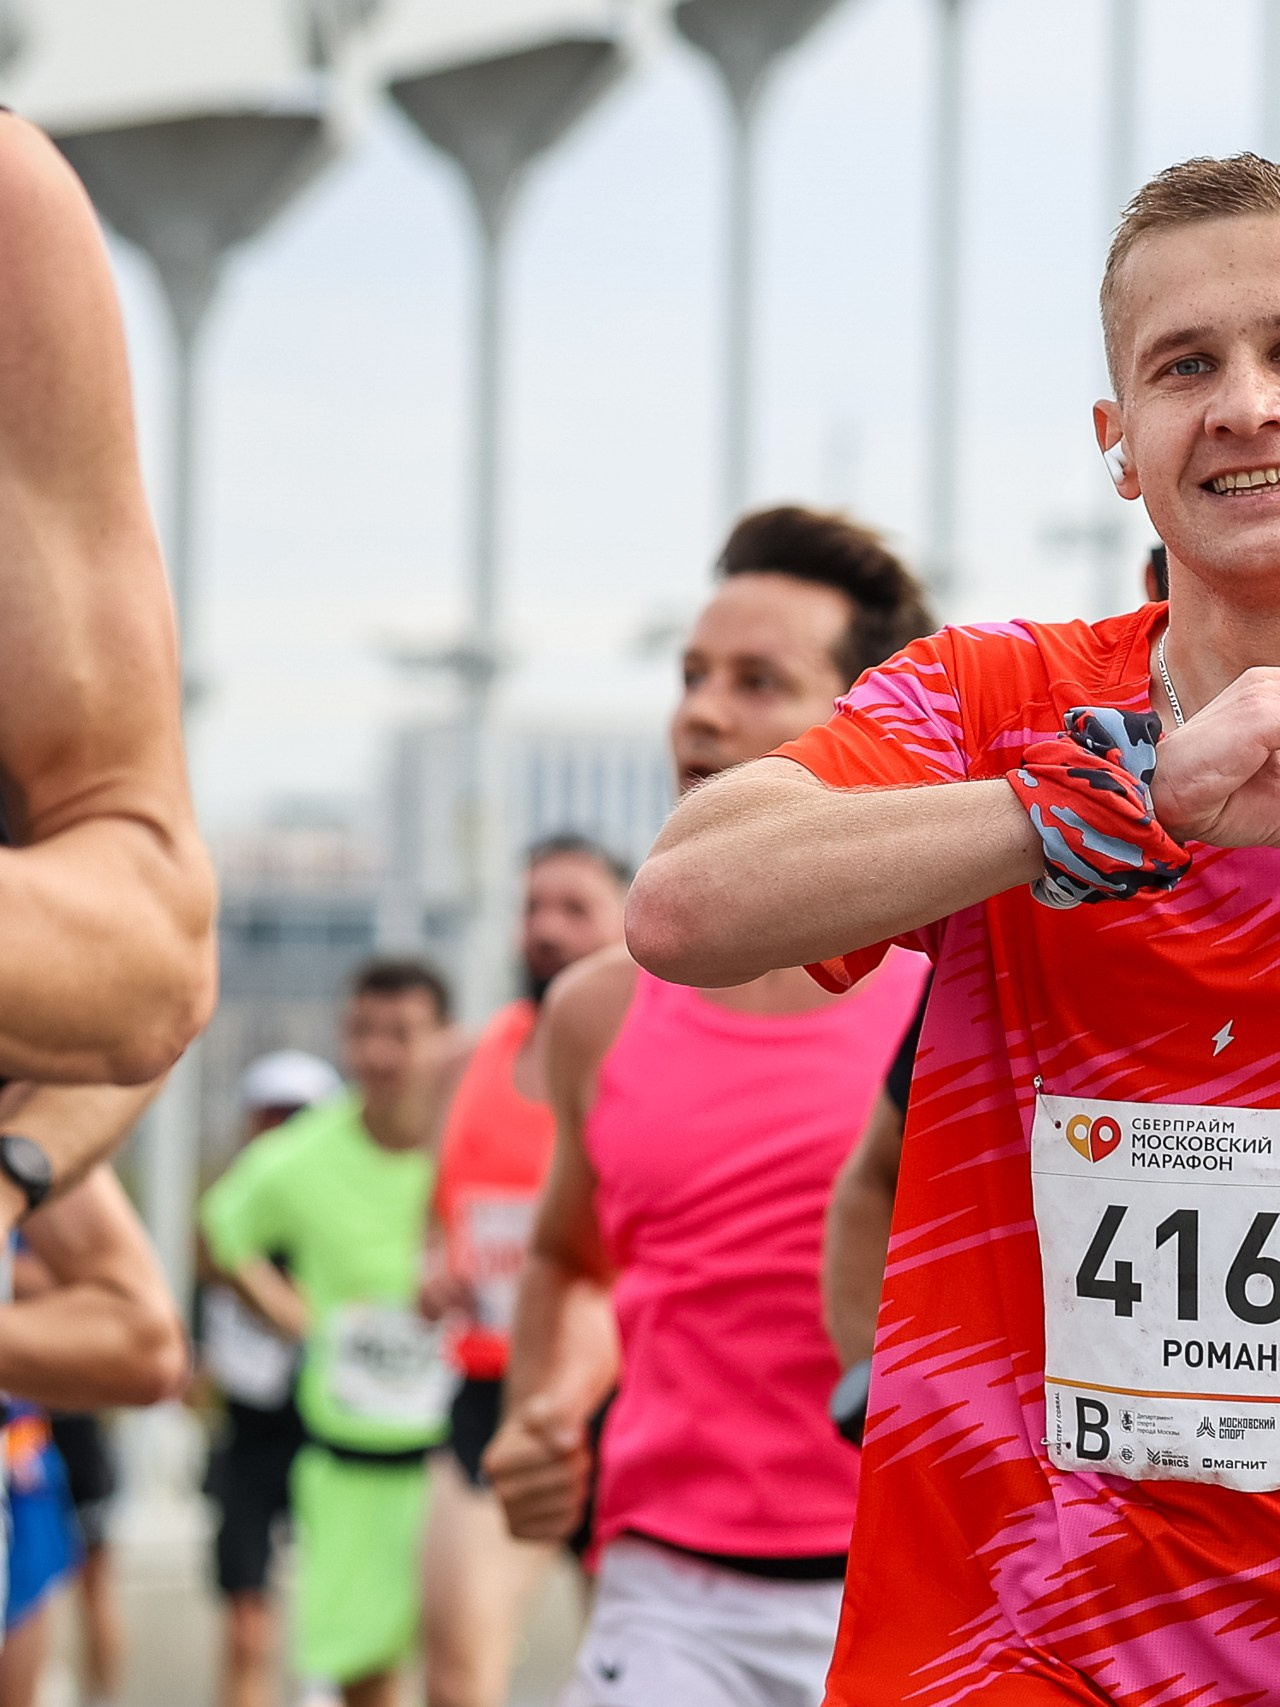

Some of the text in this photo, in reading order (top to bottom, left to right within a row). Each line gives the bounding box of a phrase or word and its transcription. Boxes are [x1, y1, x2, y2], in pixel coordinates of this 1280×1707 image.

[1131, 1117, 1235, 1133] СБЕРПРАЙМ
[1131, 1133, 1272, 1154] МОСКОВСКИЙ
[1131, 1152, 1233, 1171] МАРАФОН
[1163, 1339, 1278, 1372] РОМАН
[1219, 1416, 1276, 1430] МОСКОВСКИЙ
[1219, 1428, 1245, 1440] СПОРТ
[1161, 1458, 1189, 1468] BRICS
[1214, 1458, 1268, 1470] магнит
